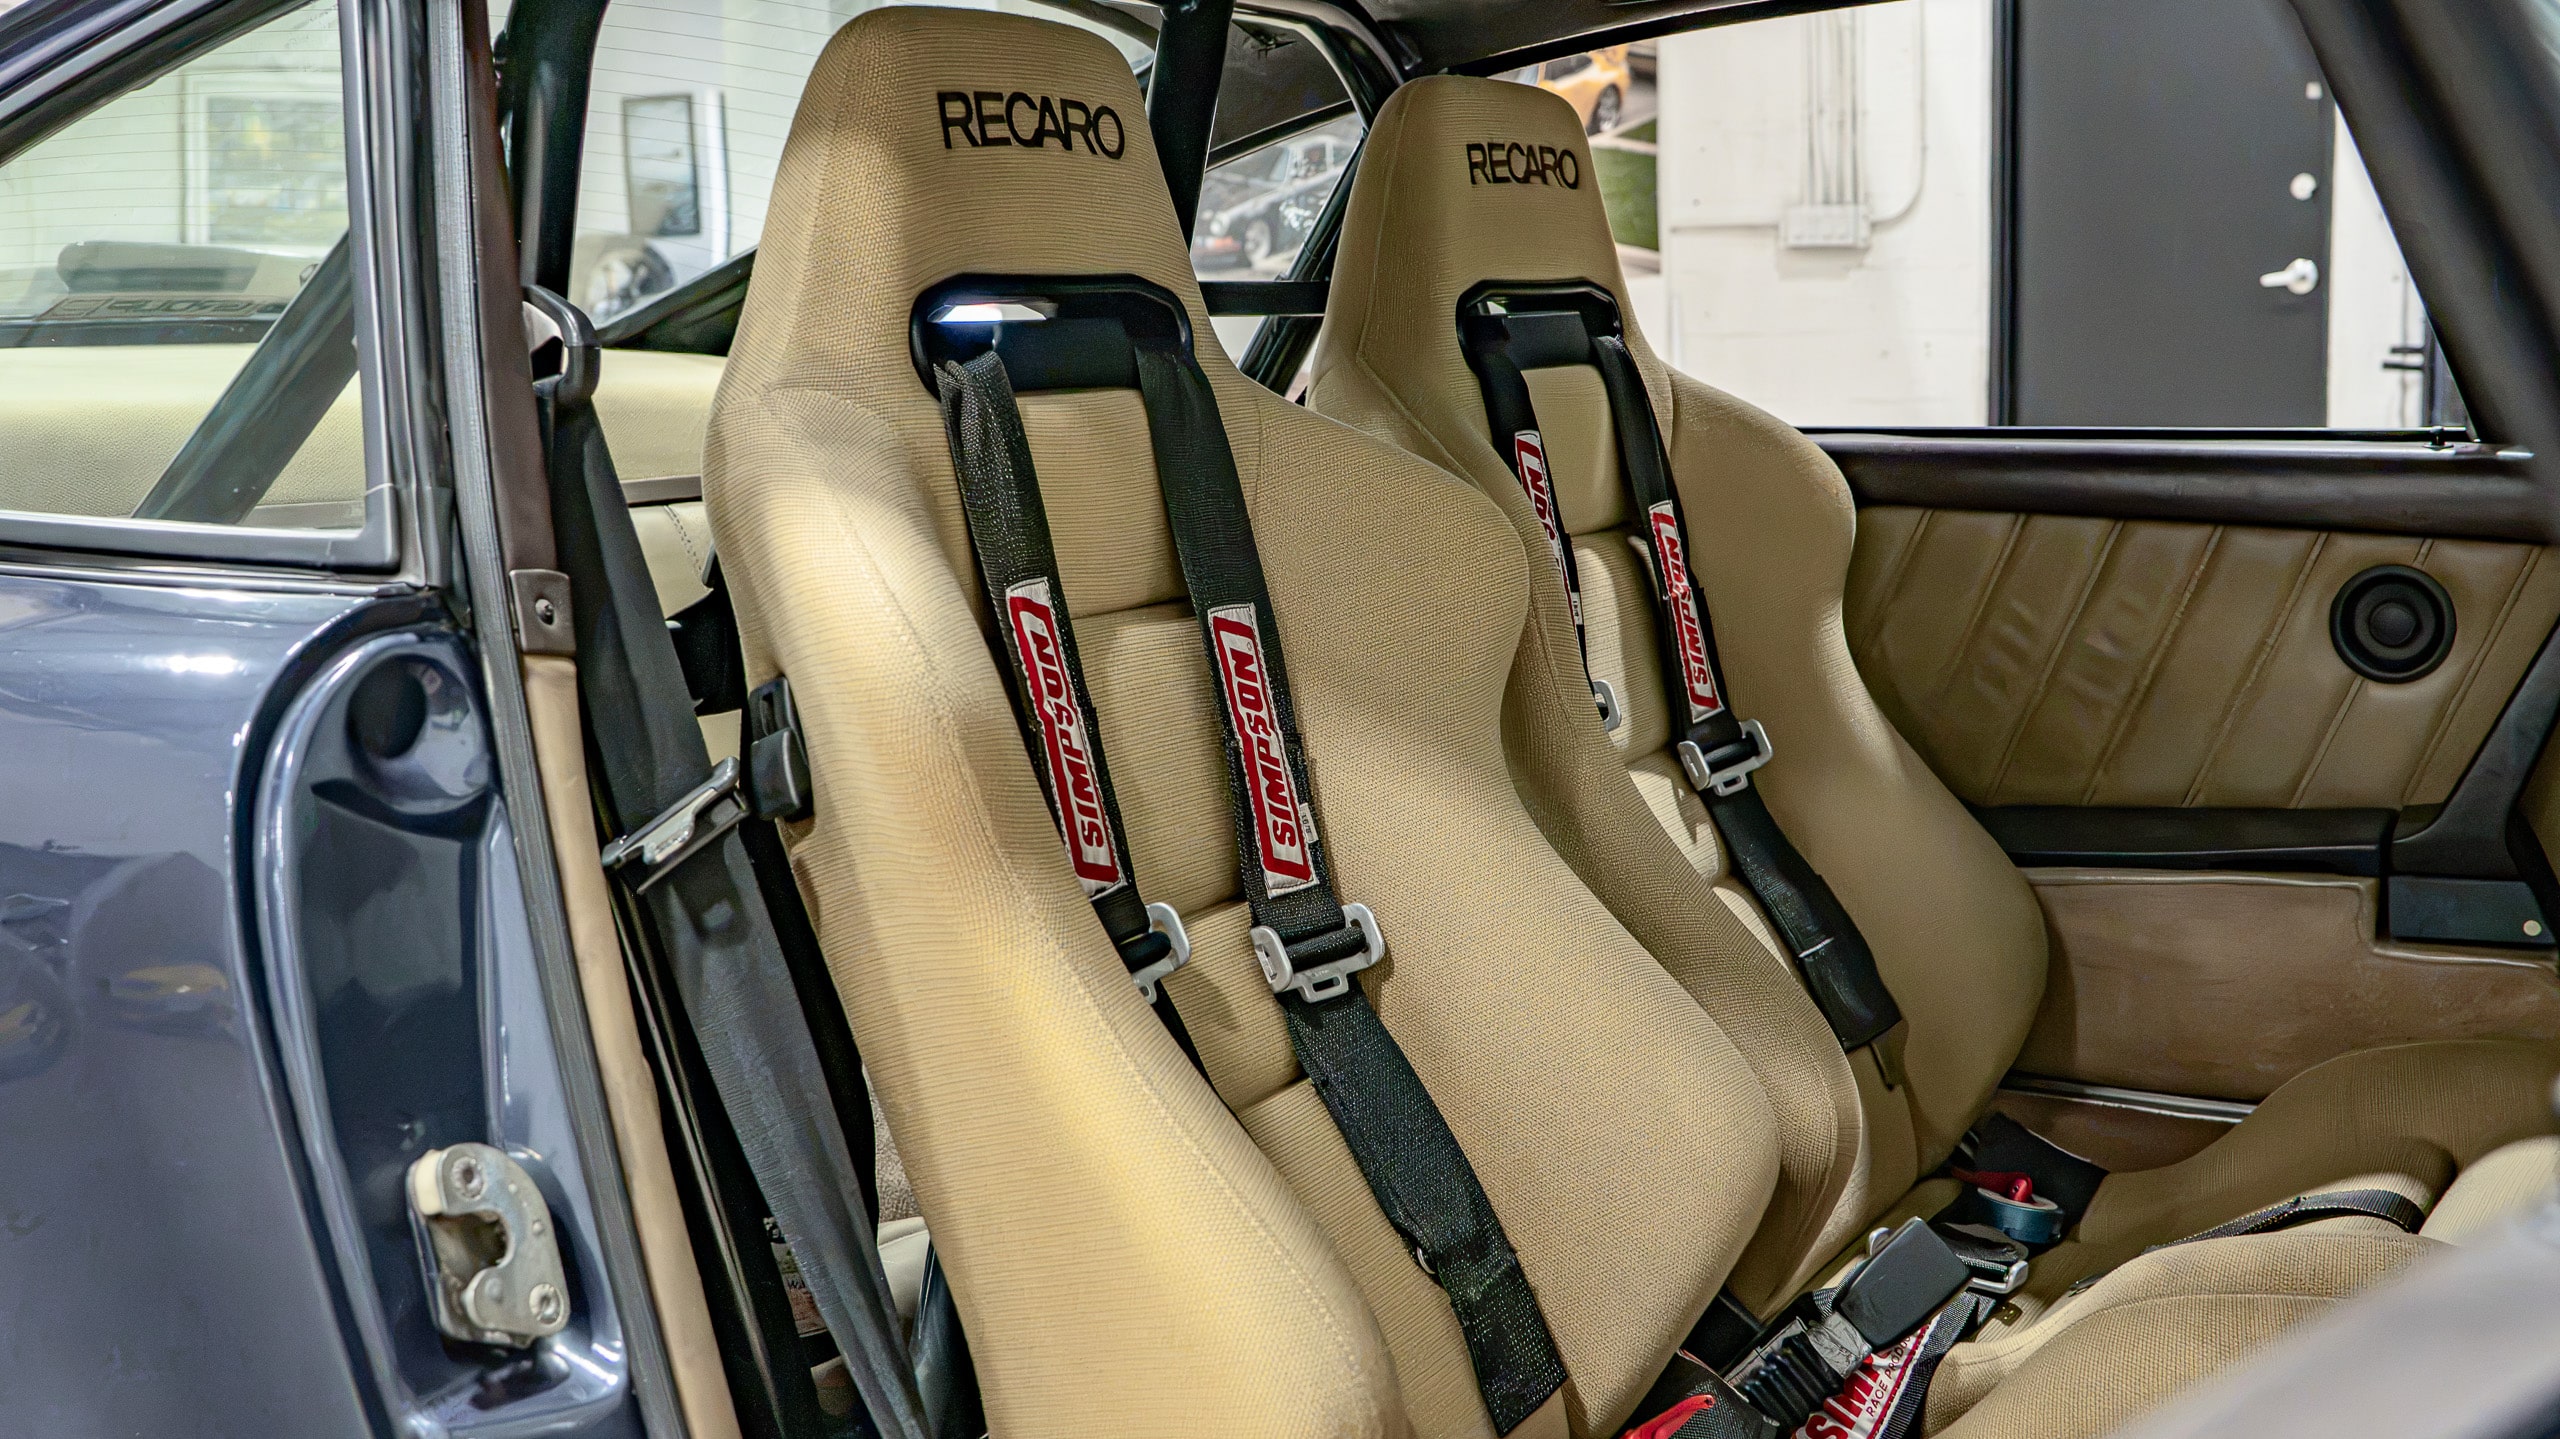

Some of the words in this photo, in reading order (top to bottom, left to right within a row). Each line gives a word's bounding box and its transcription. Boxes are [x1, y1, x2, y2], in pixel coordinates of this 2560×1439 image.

[937, 91, 1125, 160] RECARO
[1466, 142, 1579, 190] RECARO
[1665, 535, 1709, 686] SIMPSON
[1029, 628, 1105, 849] SIMPSON
[1231, 649, 1297, 848] SIMPSON
[1865, 1381, 1889, 1418] RACE
